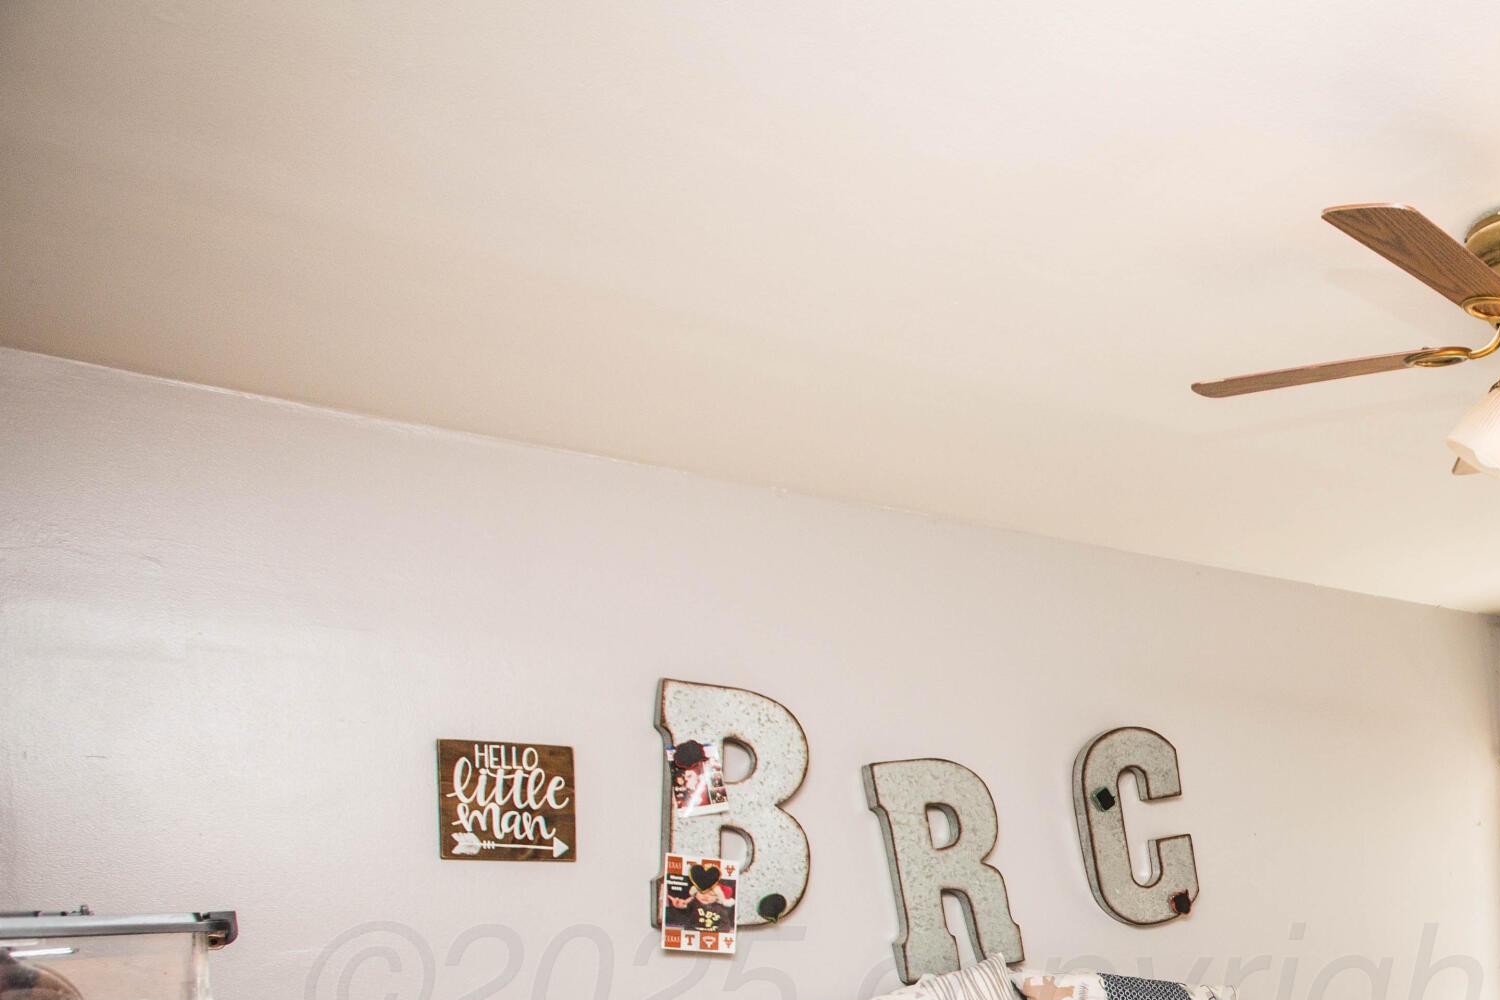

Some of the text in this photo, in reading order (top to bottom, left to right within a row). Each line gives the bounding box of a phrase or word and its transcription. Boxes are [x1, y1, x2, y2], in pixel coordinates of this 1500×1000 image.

[474, 743, 538, 771] HELLO
[446, 756, 570, 810] little
[451, 803, 557, 841] man
[650, 677, 810, 929] B
[861, 757, 1025, 985] R
